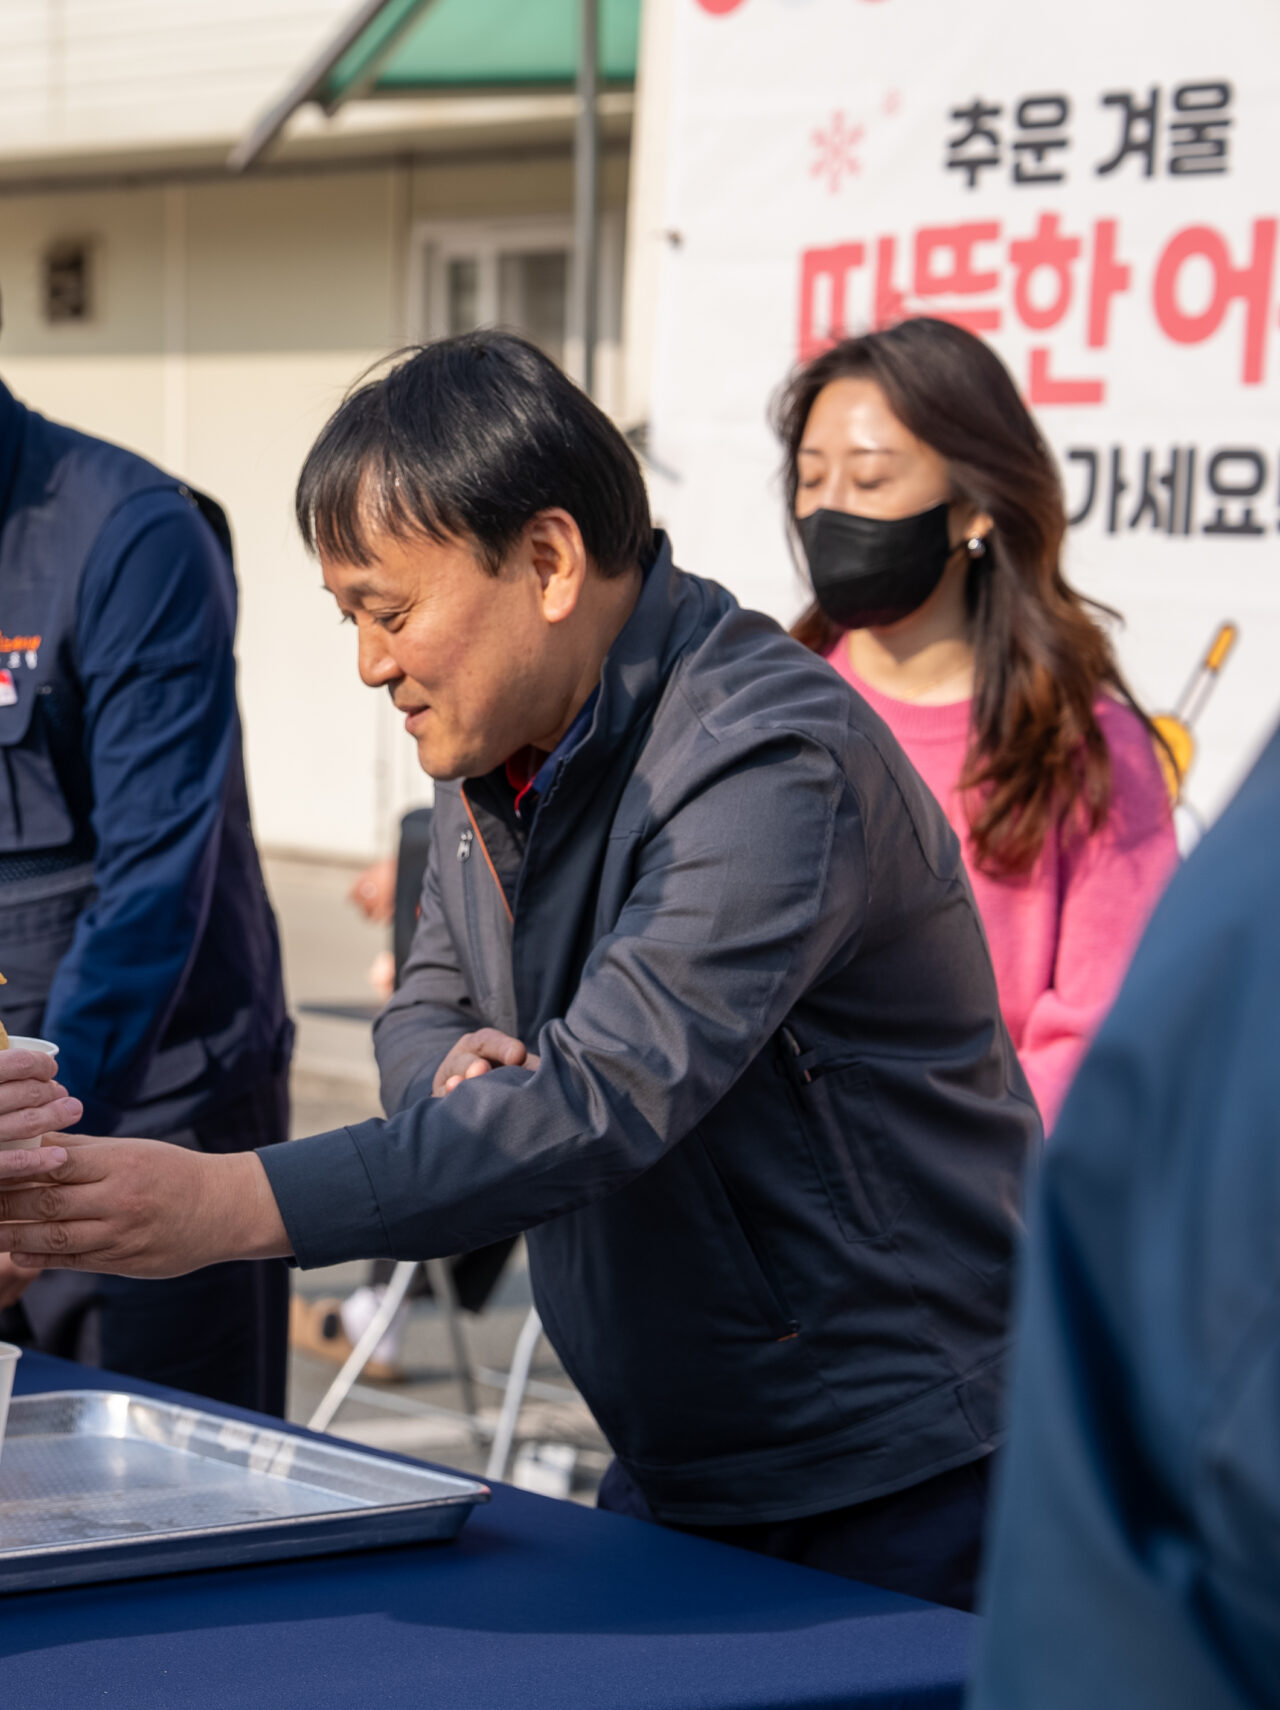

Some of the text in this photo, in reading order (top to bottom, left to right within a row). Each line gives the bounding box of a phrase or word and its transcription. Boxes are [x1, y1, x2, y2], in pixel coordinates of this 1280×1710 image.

[945, 79, 1235, 190] 추운 겨울
[1151, 216, 1280, 387] 어
